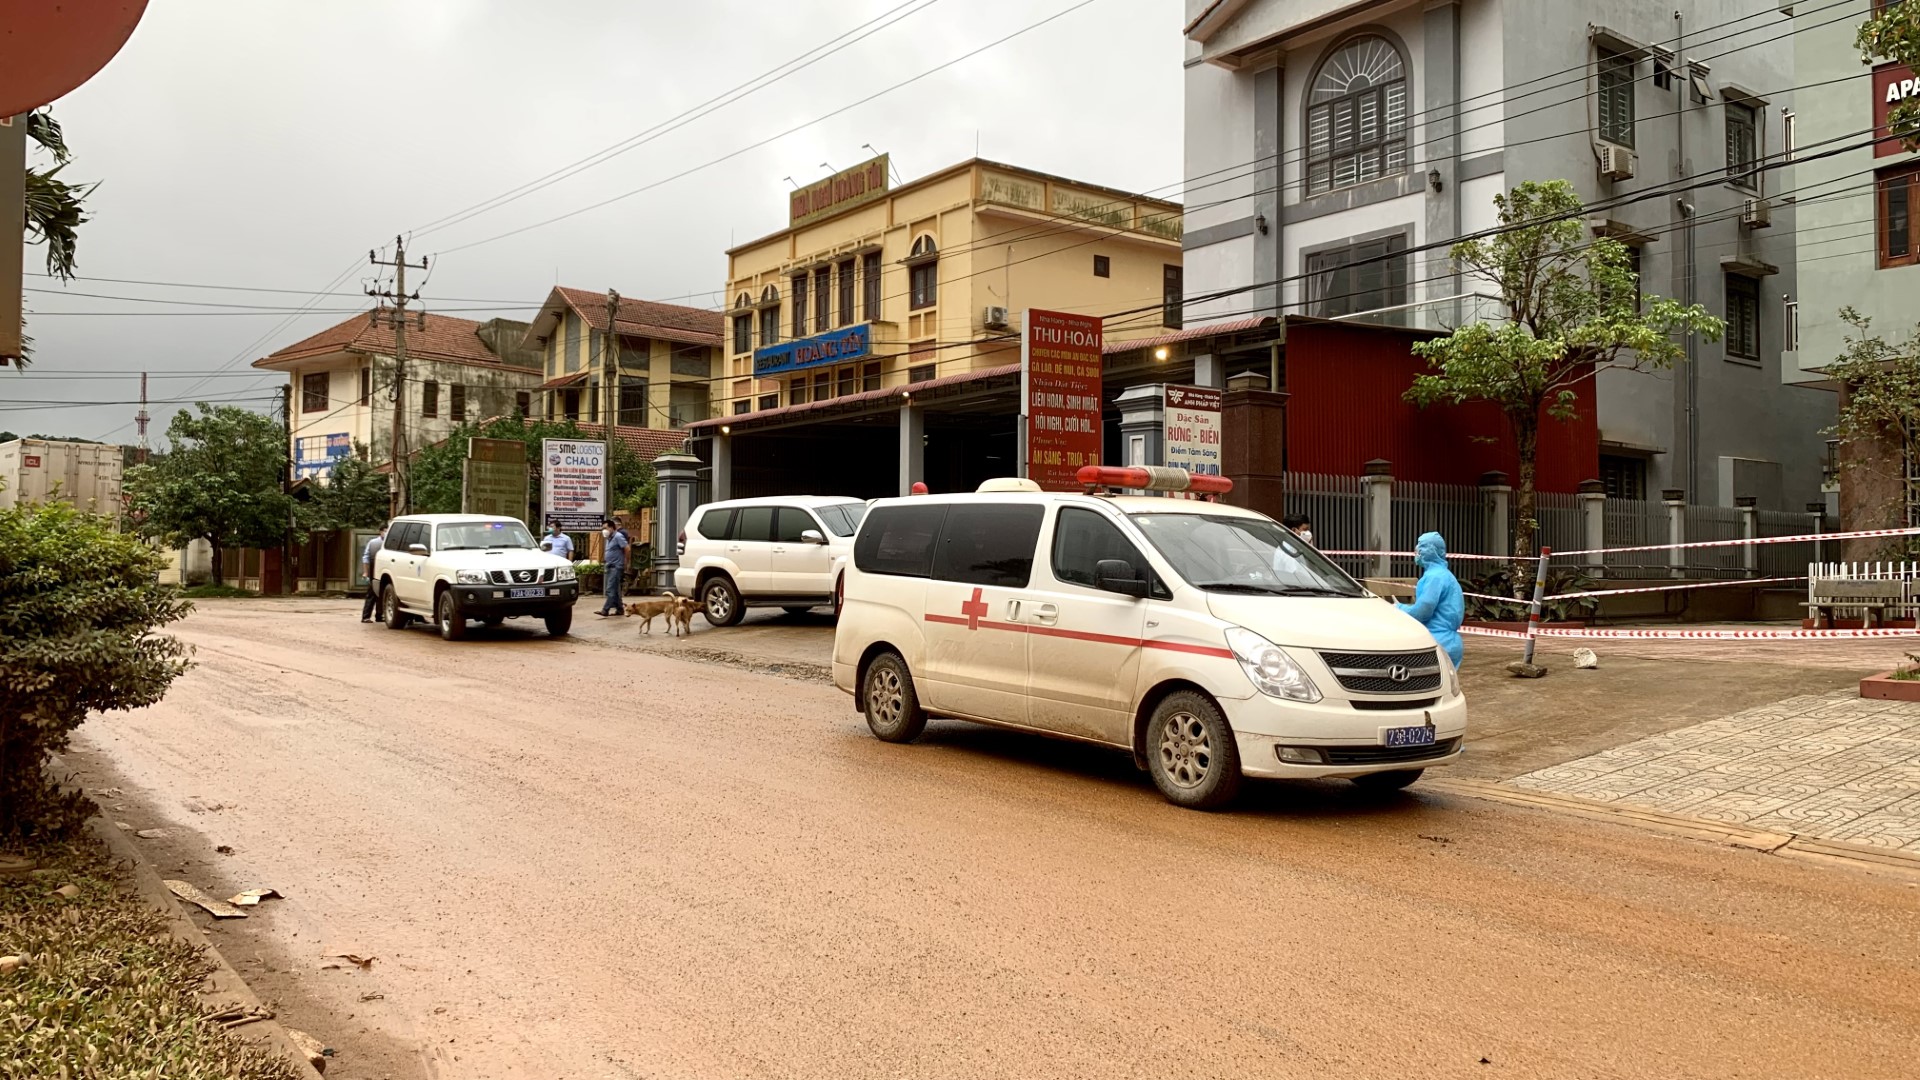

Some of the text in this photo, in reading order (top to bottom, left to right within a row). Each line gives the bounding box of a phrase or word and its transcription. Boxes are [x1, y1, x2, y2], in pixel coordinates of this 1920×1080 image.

[1033, 326, 1099, 348] THU HOÀI
[1031, 389, 1099, 414] LIÊN HOAN, SINH NHẬT,
[1035, 412, 1046, 433] HỘI
[1047, 415, 1064, 434] NGHỊ,
[1177, 413, 1209, 424] Đặc Sản
[1168, 424, 1191, 442] RỪNG
[1200, 425, 1219, 444] BIỂN
[559, 444, 576, 454] sme
[577, 445, 603, 455] LOGISTICS
[1043, 448, 1062, 465] SÁNG
[1171, 444, 1187, 454] Điểm
[565, 456, 599, 466] CHALO
[1388, 727, 1433, 745] 73B-0275
